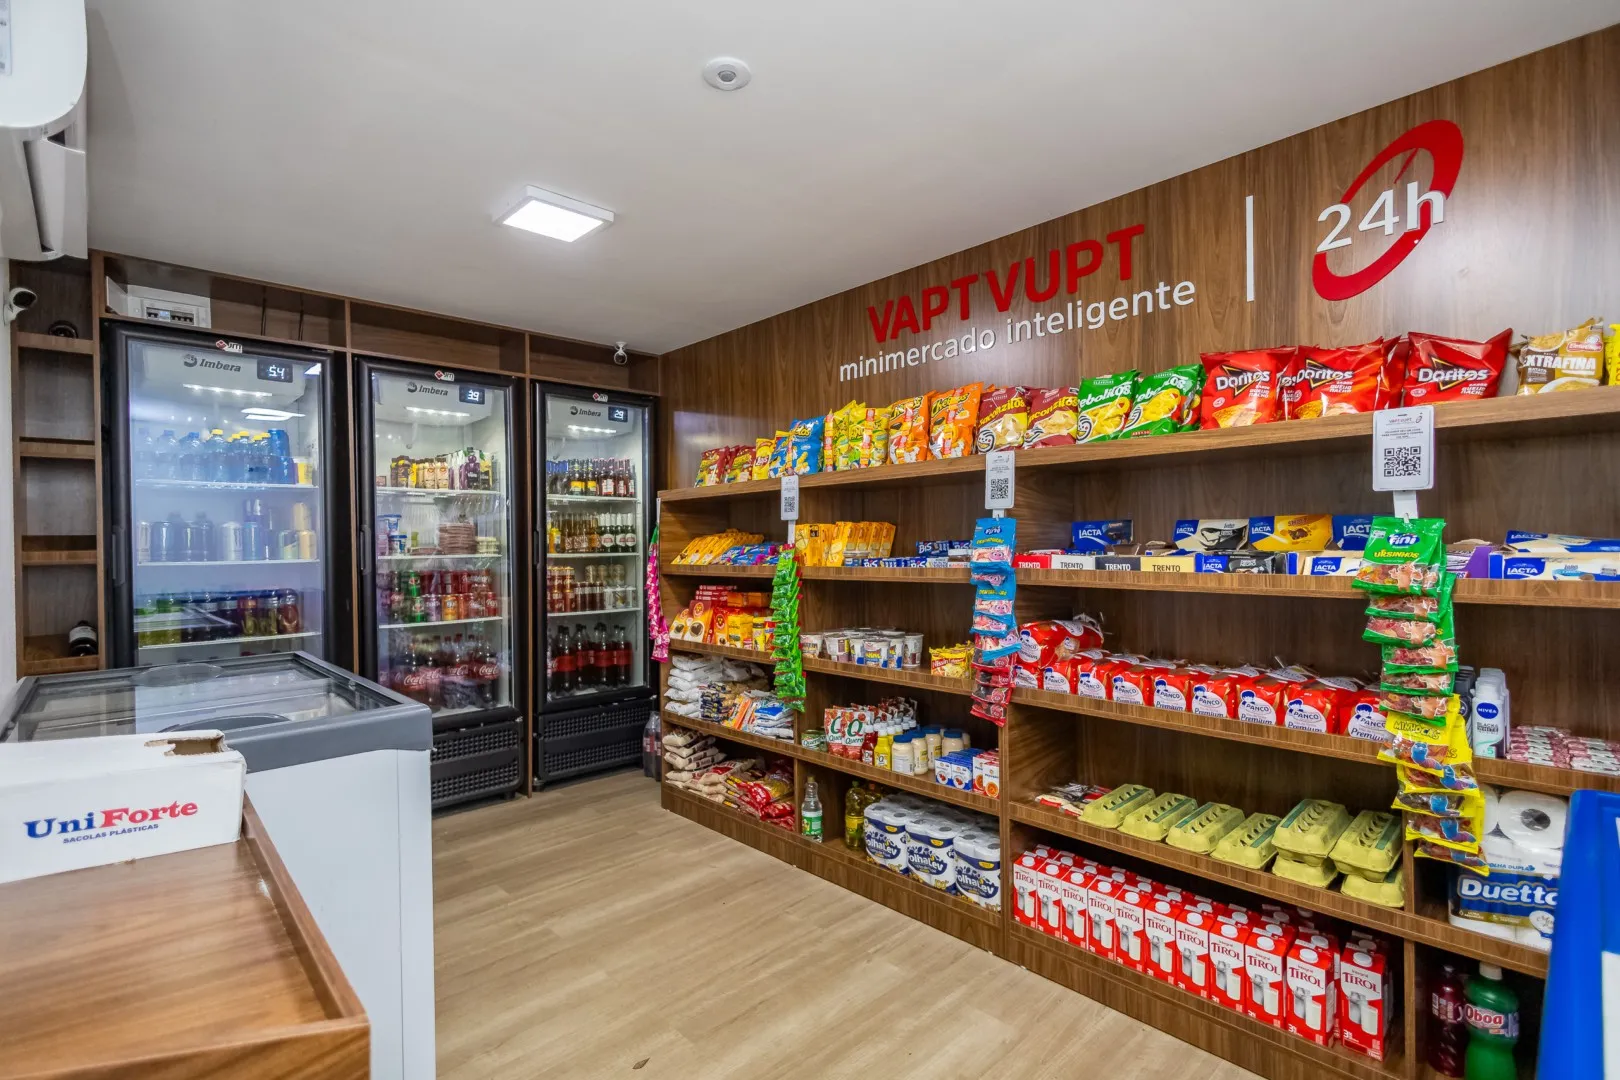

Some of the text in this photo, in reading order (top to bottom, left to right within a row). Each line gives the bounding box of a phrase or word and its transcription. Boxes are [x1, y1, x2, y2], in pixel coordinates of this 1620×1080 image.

[1317, 182, 1446, 254] 24h
[867, 224, 1145, 344] VAPT VUPT
[839, 280, 1197, 382] minimercado inteligente
[199, 358, 241, 372] Imbera
[1216, 370, 1271, 390] Doritos
[1296, 368, 1353, 383] Doritos
[1418, 368, 1489, 382] Doritos
[418, 384, 449, 396] Imbera
[1079, 382, 1132, 408] ebolitos
[579, 408, 602, 417] Imbera
[1079, 529, 1102, 538] LACTA
[1176, 527, 1195, 535] LACTA
[1252, 525, 1272, 534] LACTA
[1343, 524, 1371, 536] LACT
[1018, 561, 1041, 569] TRENTO
[1152, 564, 1181, 572] TRENTO
[1507, 567, 1538, 575] LACTA
[1199, 697, 1220, 706] PANCO
[1246, 703, 1270, 711] PANCO
[1241, 714, 1273, 725] Premium
[1293, 711, 1319, 720] PANCO
[847, 719, 864, 737] Q
[845, 737, 864, 745] Quero
[63, 823, 159, 844] SACOLAS PLÁSTICAS
[1015, 871, 1035, 886] TIROL
[1039, 880, 1060, 895] TIROL
[1063, 888, 1086, 904] TIROL
[1090, 898, 1114, 914] TIROL
[1116, 907, 1142, 925] TIROL
[1146, 918, 1174, 936] TIROL
[1178, 930, 1207, 949] TIROL
[1211, 942, 1242, 961] TIROL
[1247, 955, 1280, 975] TIROL
[1289, 966, 1324, 989] TIROL
[1342, 971, 1380, 993] TIROL
